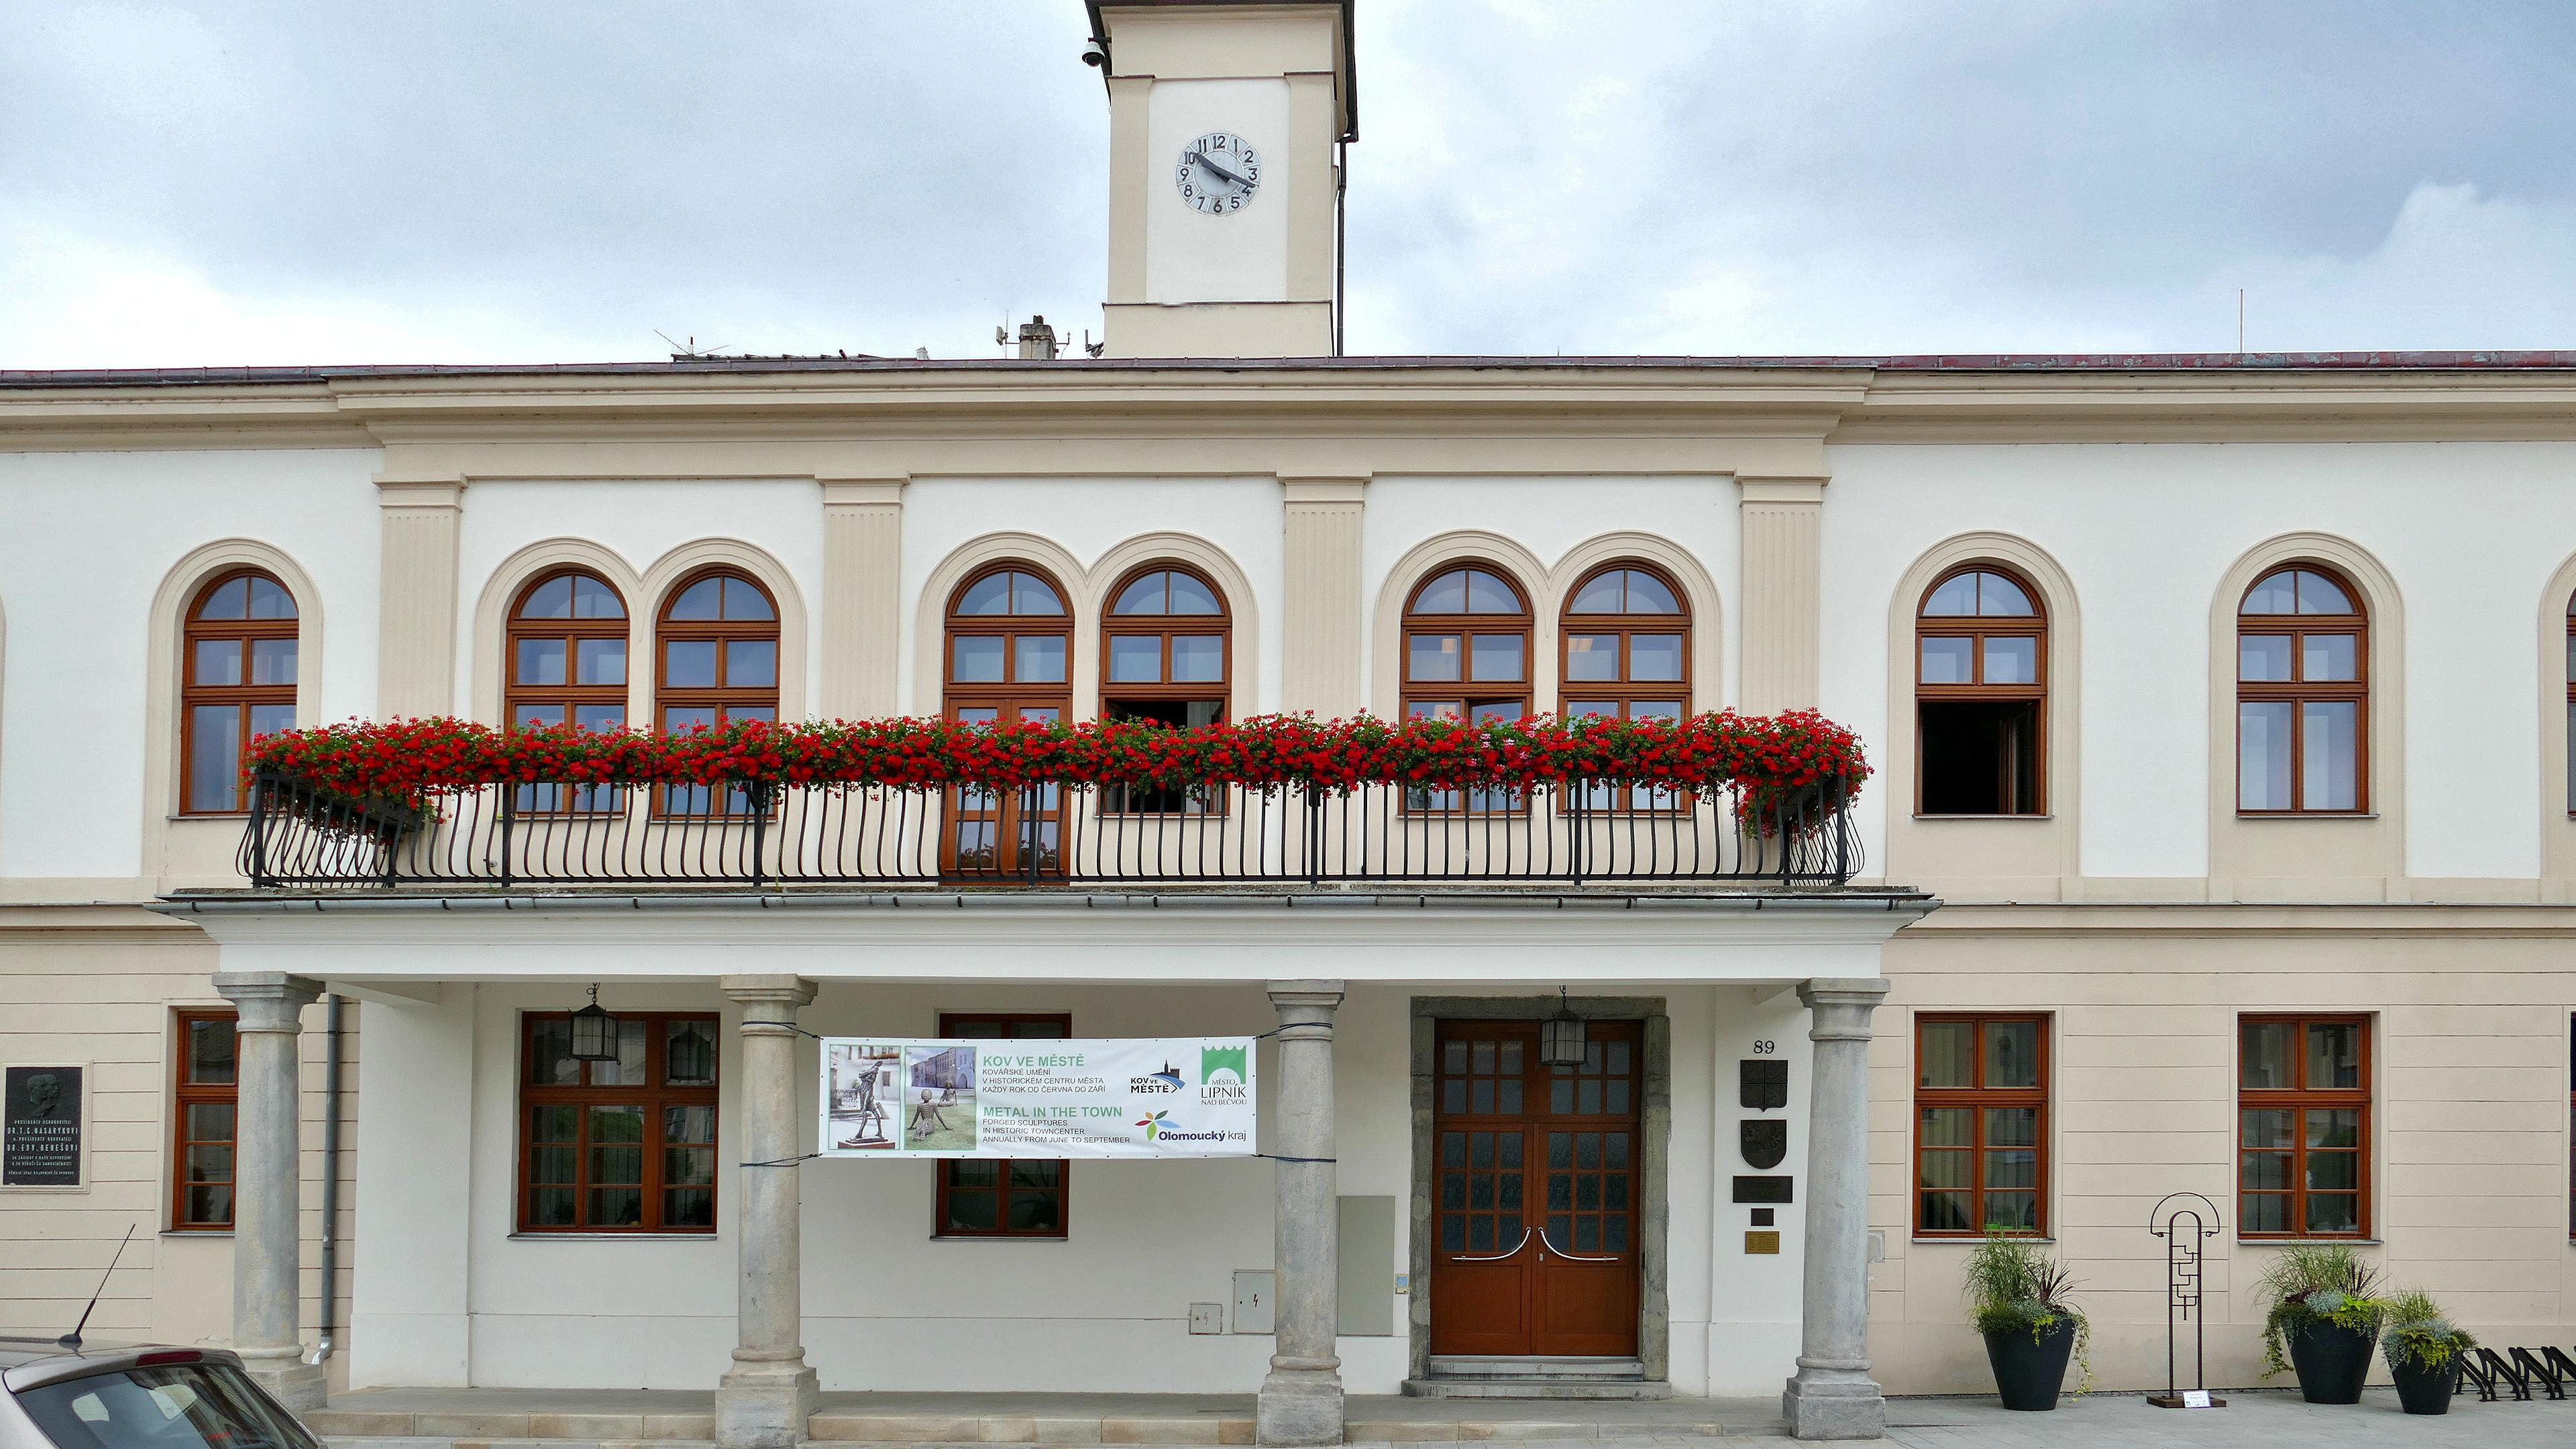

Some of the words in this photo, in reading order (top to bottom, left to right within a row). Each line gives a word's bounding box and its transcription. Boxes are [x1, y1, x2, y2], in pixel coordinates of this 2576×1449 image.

[1197, 139, 1207, 153] 11
[1213, 136, 1226, 149] 12
[1234, 139, 1238, 152] 1
[1184, 152, 1196, 165] 10
[1244, 150, 1254, 163] 2
[1180, 168, 1189, 180] 9
[1248, 168, 1258, 180] 3
[1183, 184, 1193, 197] 8
[1241, 186, 1252, 197] 4
[1197, 196, 1205, 209] 7
[1213, 199, 1222, 213] 6
[1230, 197, 1240, 209] 5
[1753, 1040, 1776, 1054] 89
[983, 1056, 1012, 1067] KOV
[1016, 1056, 1034, 1067] VE
[1038, 1053, 1085, 1067] MĚSTĚ
[982, 1067, 1024, 1075] KOVÁŘSKÉ
[1026, 1067, 1051, 1075] UMĚNÍ
[989, 1076, 1042, 1084] HISTORICKÉM
[982, 1085, 1007, 1093] KAŽDÝ
[1041, 1085, 1073, 1093] ČERVNA
[1087, 1085, 1106, 1093] ZÁŘÍ
[1201, 1084, 1246, 1098] LIPNÍK
[983, 1106, 1030, 1117] METAL
[1033, 1107, 1046, 1117] IN
[1051, 1107, 1077, 1117] THE
[1081, 1107, 1122, 1117] TOWN
[1158, 1130, 1226, 1142] Olomoucký
[1228, 1130, 1246, 1142] kraj
